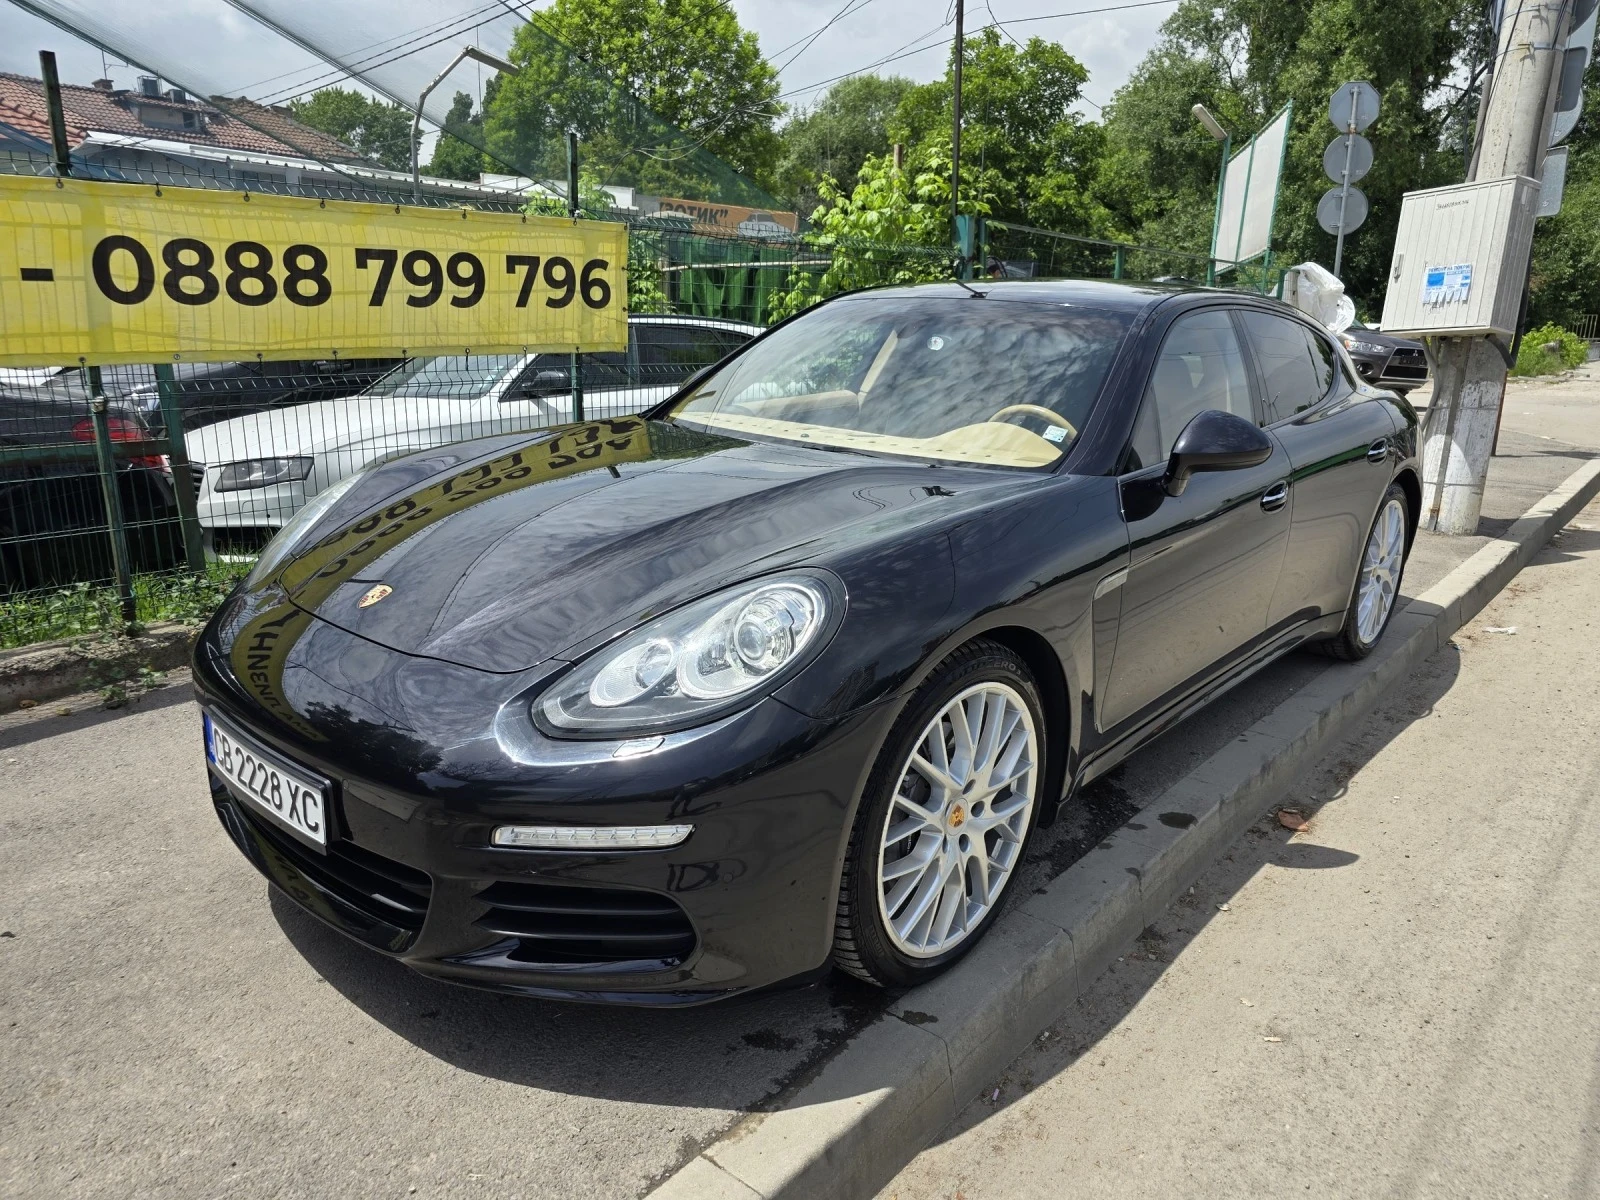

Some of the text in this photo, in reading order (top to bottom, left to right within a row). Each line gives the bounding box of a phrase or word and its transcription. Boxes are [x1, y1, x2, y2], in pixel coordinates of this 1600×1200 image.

[92, 234, 332, 306] 0888
[355, 247, 487, 308] 799
[505, 254, 611, 309] 796
